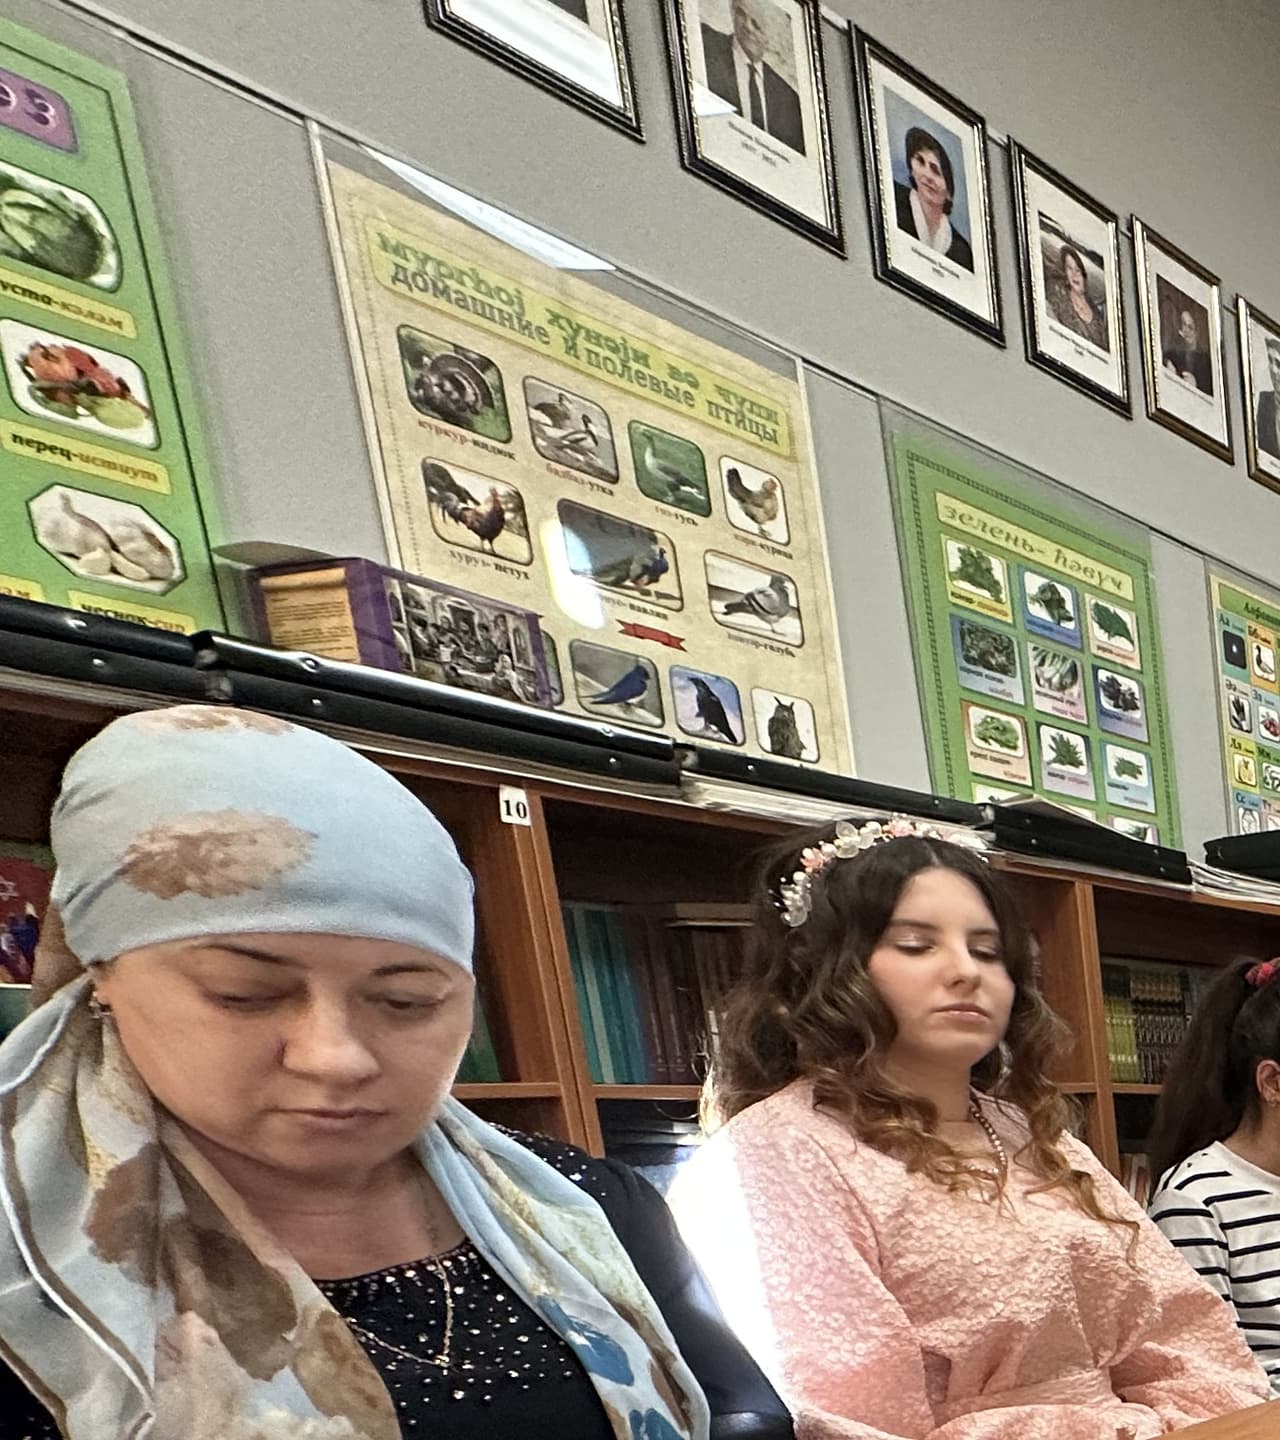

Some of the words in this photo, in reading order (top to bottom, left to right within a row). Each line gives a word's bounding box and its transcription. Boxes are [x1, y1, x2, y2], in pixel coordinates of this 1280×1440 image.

[586, 348, 695, 408] полевые
[706, 400, 778, 444] птицы
[503, 800, 527, 819] 10
